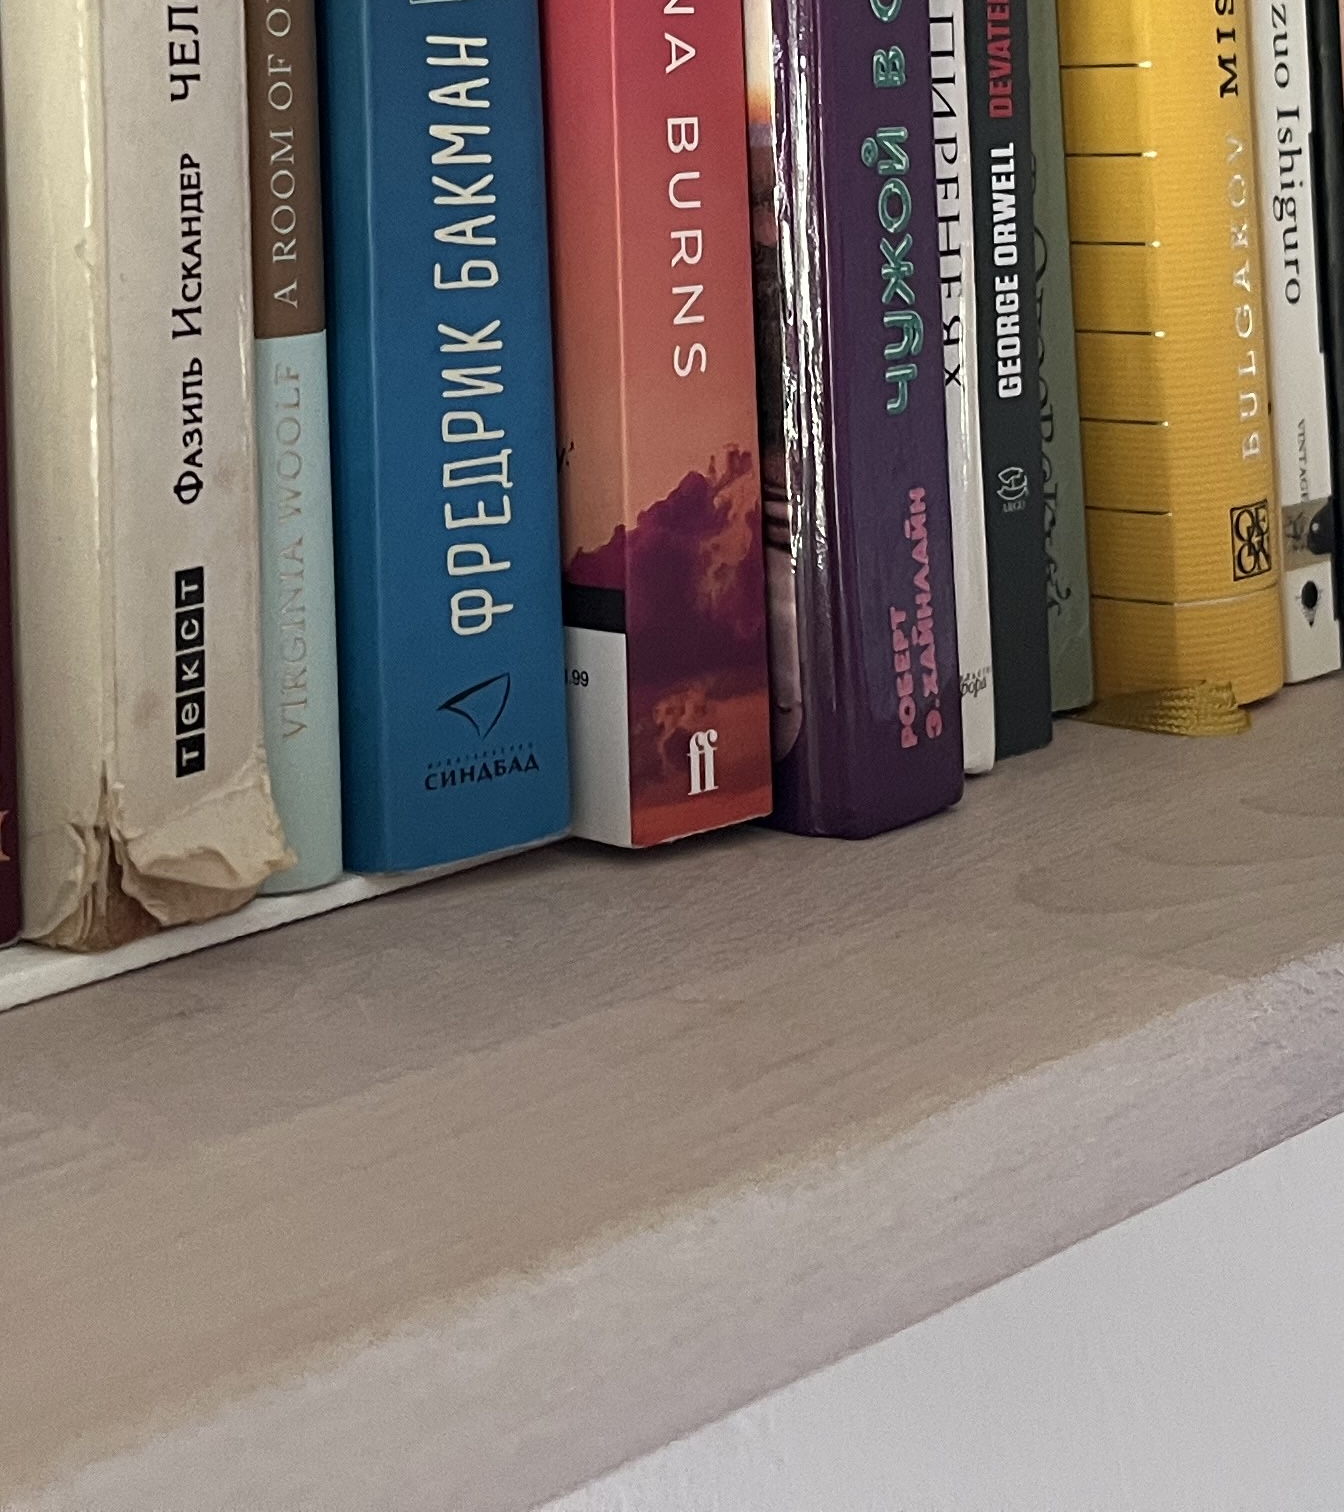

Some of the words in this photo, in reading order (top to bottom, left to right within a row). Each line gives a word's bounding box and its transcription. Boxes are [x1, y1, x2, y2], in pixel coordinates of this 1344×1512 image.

[267, 53, 293, 111] OF
[872, 44, 907, 89] В
[270, 125, 298, 264] ROOM
[425, 34, 500, 291] БАКМАН
[990, 141, 1018, 268] ORWELL
[1272, 105, 1305, 307] Ishiguro
[274, 281, 298, 308] A
[667, 115, 707, 378] BURNS
[860, 126, 924, 416] ЧУЖОЙ
[1226, 134, 1262, 462] BULGAKOV
[994, 274, 1022, 400] GEORGE
[276, 365, 303, 522] WOOLF
[436, 318, 514, 636] ФРЕДРИК
[280, 532, 306, 741] VIRGINIA
[890, 606, 918, 749] РОБЕРТ
[424, 753, 540, 790] СИНДБАД
